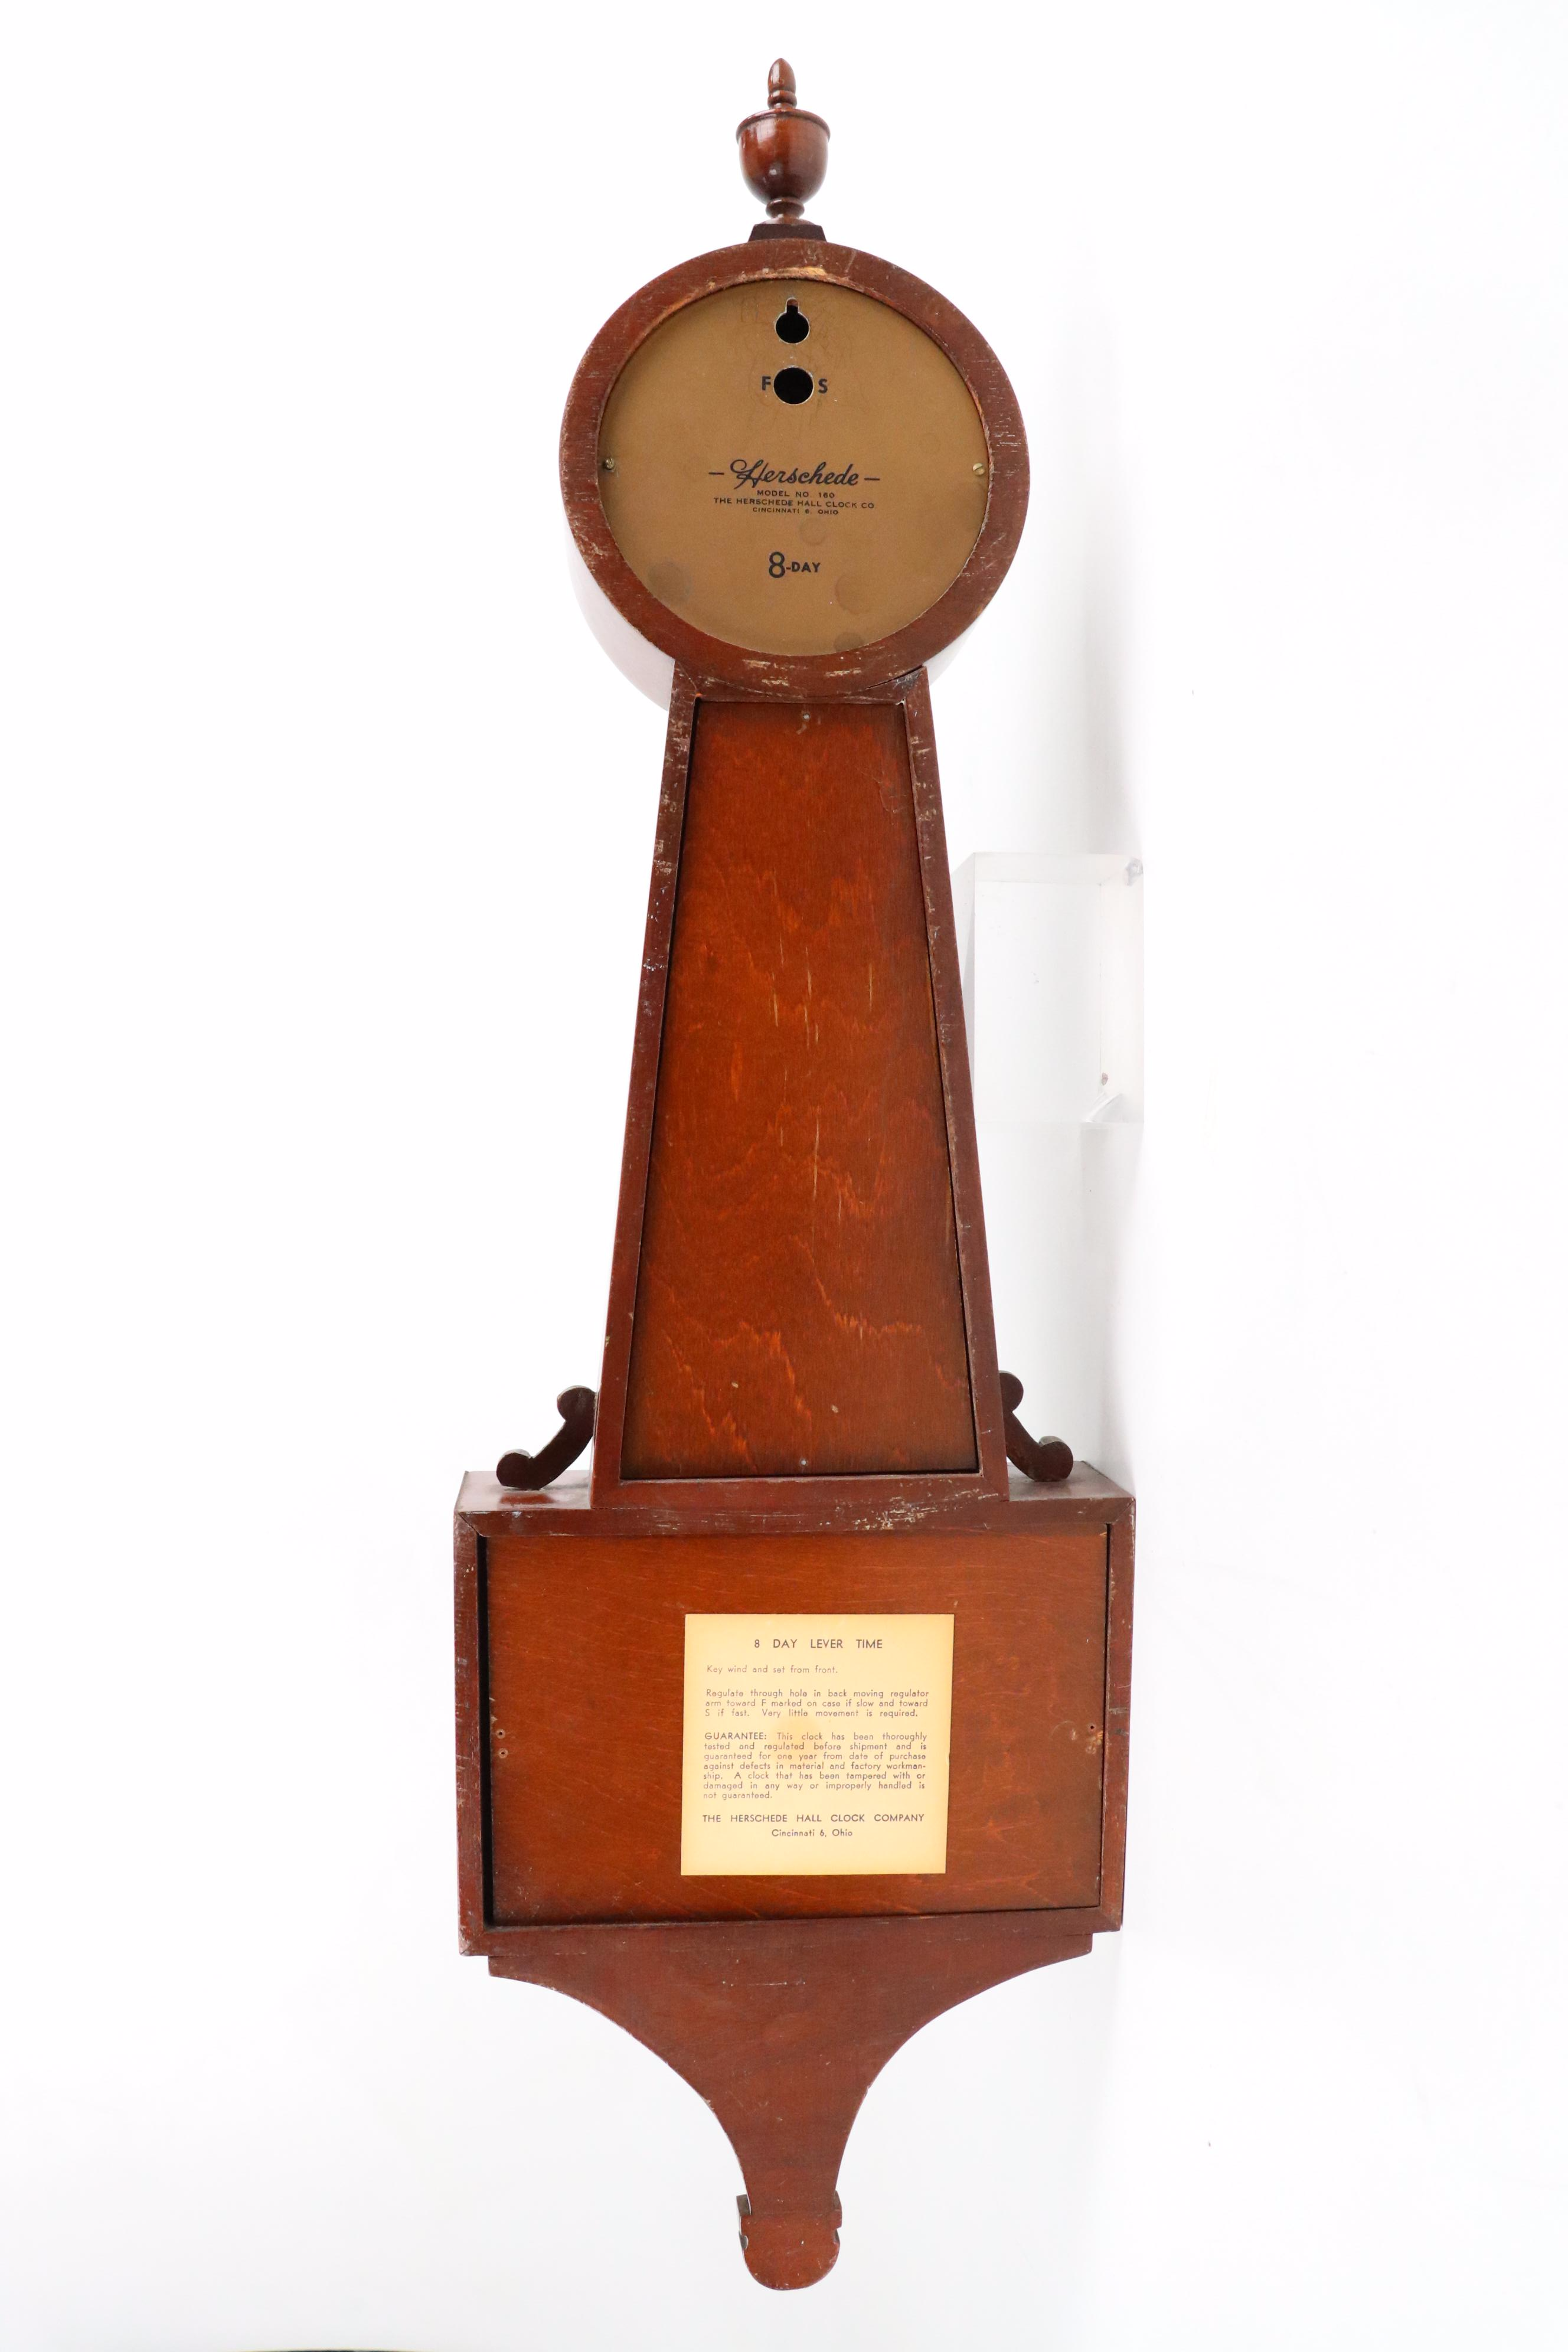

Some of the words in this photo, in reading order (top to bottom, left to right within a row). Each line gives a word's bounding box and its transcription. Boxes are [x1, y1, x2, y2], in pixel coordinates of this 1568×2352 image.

[762, 375, 772, 391] F
[818, 378, 828, 394] S
[730, 459, 860, 490] Herschede
[736, 498, 793, 507] HERSCHEDE
[825, 501, 857, 509] CLOCK
[768, 551, 821, 579] 8-DAY
[754, 1639, 760, 1648] 8
[773, 1638, 798, 1649] DAY
[810, 1638, 844, 1649] LEVER
[855, 1639, 883, 1649] TIME
[707, 1664, 723, 1675] Key
[727, 1664, 747, 1673] wind
[752, 1664, 768, 1673] and
[773, 1665, 785, 1674] set
[790, 1664, 810, 1674] from
[814, 1664, 838, 1674] front.
[706, 1688, 744, 1698] Regulate
[750, 1688, 783, 1699] through
[789, 1688, 808, 1697] hole
[814, 1689, 821, 1697] in
[828, 1688, 847, 1697] back
[853, 1689, 884, 1699] moving
[890, 1688, 929, 1699] regulator
[727, 1698, 756, 1707] toward
[761, 1698, 767, 1707] F
[771, 1698, 802, 1707] marked
[845, 1698, 852, 1707] if
[856, 1698, 874, 1707] slow
[878, 1698, 894, 1707] and
[899, 1698, 928, 1707] toward
[705, 1709, 710, 1717] S
[718, 1708, 724, 1717] if
[731, 1708, 750, 1717] fast.
[762, 1708, 781, 1719] Very
[789, 1708, 808, 1717] little
[815, 1709, 859, 1717] movement
[866, 1709, 873, 1717] is
[880, 1709, 918, 1719] required.
[704, 1732, 767, 1740] GUARANTEE:
[776, 1732, 793, 1740] This
[801, 1732, 823, 1740] clock
[831, 1732, 845, 1740] has
[853, 1732, 874, 1740] been
[882, 1731, 927, 1744] thoroughly
[704, 1742, 730, 1750] tested
[739, 1742, 755, 1750] and
[764, 1741, 805, 1752] regulated
[814, 1741, 841, 1750] before
[850, 1742, 888, 1752] shipment
[896, 1742, 912, 1750] and
[920, 1742, 927, 1750] is
[704, 1751, 752, 1762] guaranteed
[759, 1751, 772, 1760] for
[823, 1751, 842, 1760] from
[848, 1752, 868, 1760] date
[874, 1751, 884, 1760] of
[889, 1752, 926, 1762] purchase
[703, 1762, 734, 1772] against
[739, 1761, 770, 1770] defects
[776, 1762, 784, 1770] in
[789, 1761, 824, 1770] material
[829, 1761, 845, 1770] and
[850, 1761, 881, 1772] factory
[886, 1761, 926, 1770] workman-
[703, 1771, 723, 1782] ship.
[747, 1770, 769, 1779] clock
[776, 1771, 793, 1779] that
[799, 1771, 813, 1779] has
[819, 1770, 839, 1779] been
[846, 1770, 887, 1781] tampered
[893, 1770, 910, 1779] with
[703, 1781, 743, 1791] damaged
[750, 1781, 757, 1789] in
[826, 1781, 872, 1791] improperly
[878, 1781, 912, 1789] handled
[919, 1781, 925, 1789] is
[721, 1790, 773, 1801] guaranteed.
[702, 1814, 721, 1822] THE
[730, 1814, 788, 1822] HERSCHEDE
[796, 1814, 822, 1822] HALL
[830, 1814, 865, 1822] CLOCK
[874, 1814, 925, 1822] COMPANY
[771, 1828, 815, 1837] Cincinnati
[819, 1829, 827, 1838] 6,
[831, 1828, 853, 1837] Ohio
